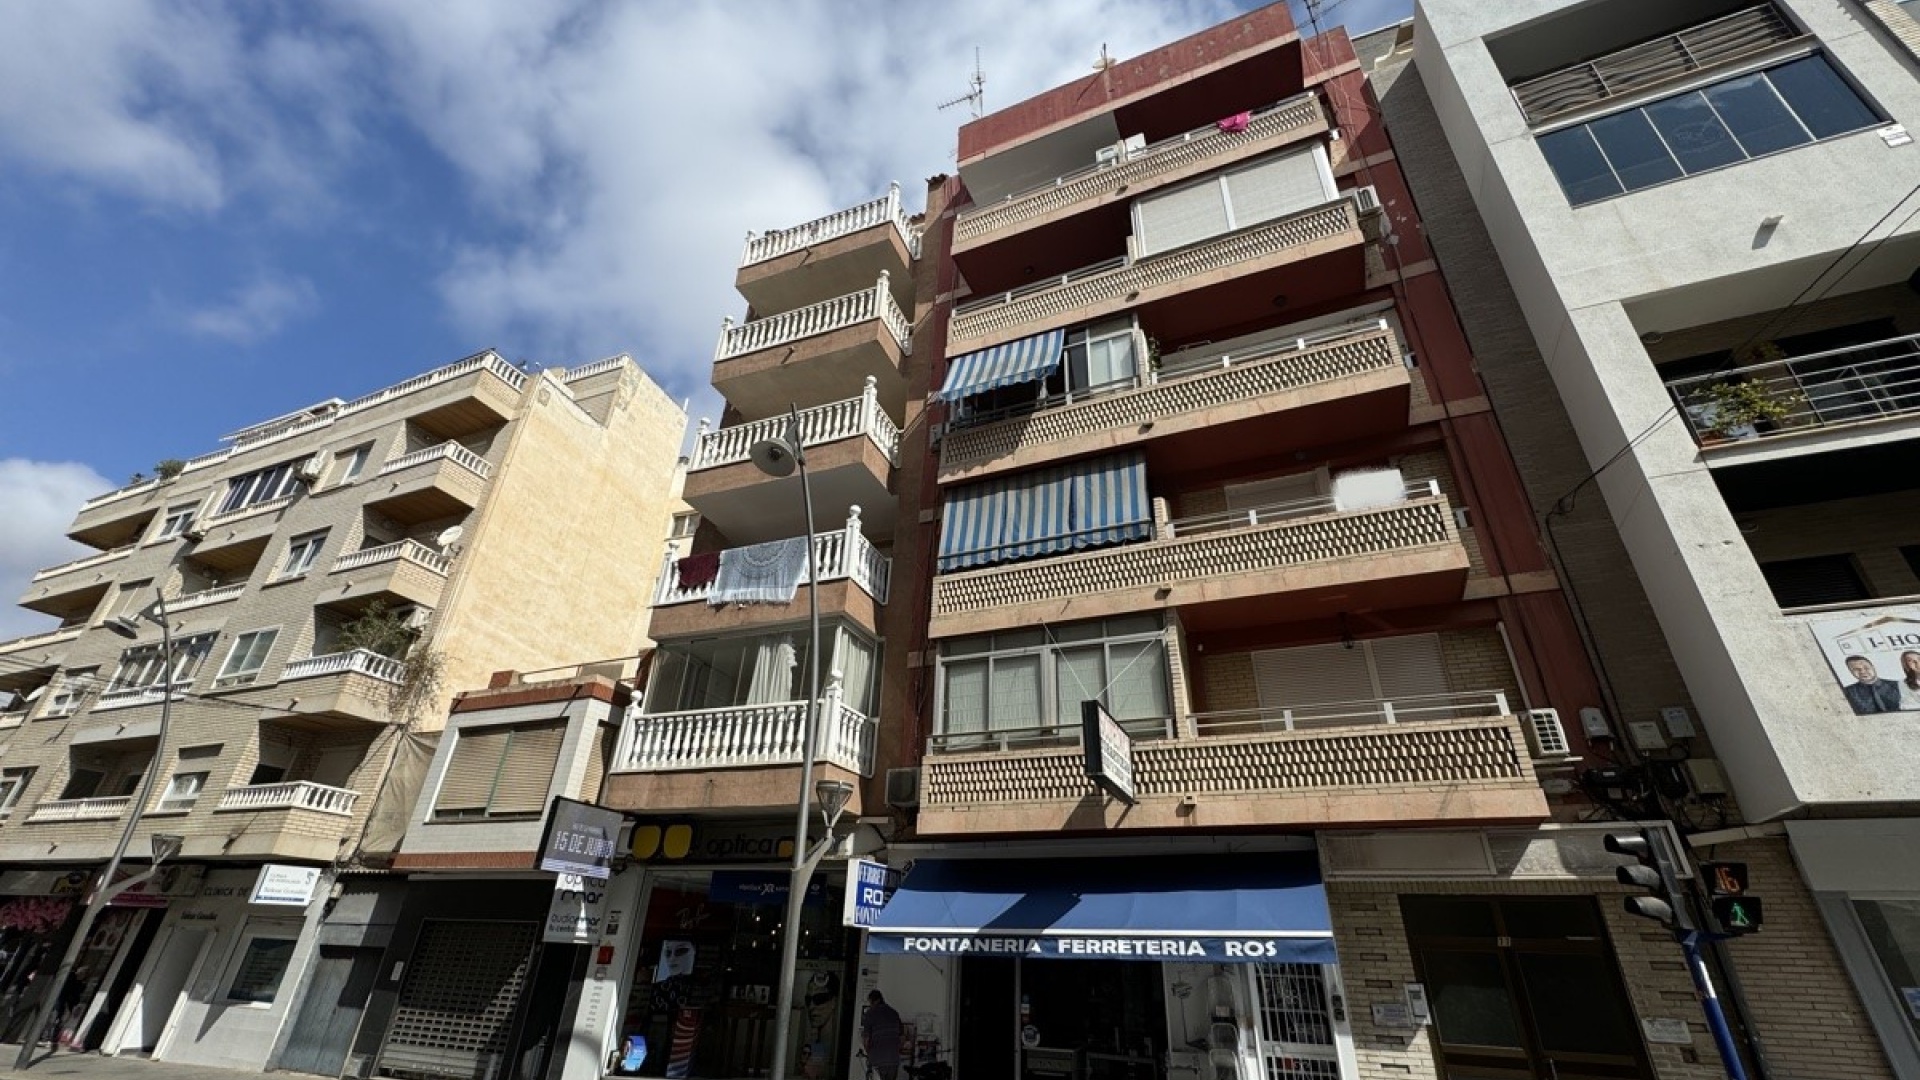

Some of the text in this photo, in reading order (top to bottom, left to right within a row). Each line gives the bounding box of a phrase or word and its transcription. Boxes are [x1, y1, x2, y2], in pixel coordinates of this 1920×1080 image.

[554, 831, 569, 851] 15
[568, 834, 585, 854] DE
[707, 833, 771, 857] optica
[561, 890, 603, 904] mar
[903, 937, 1278, 957] FONTANERIA FERRETERIA ROS
